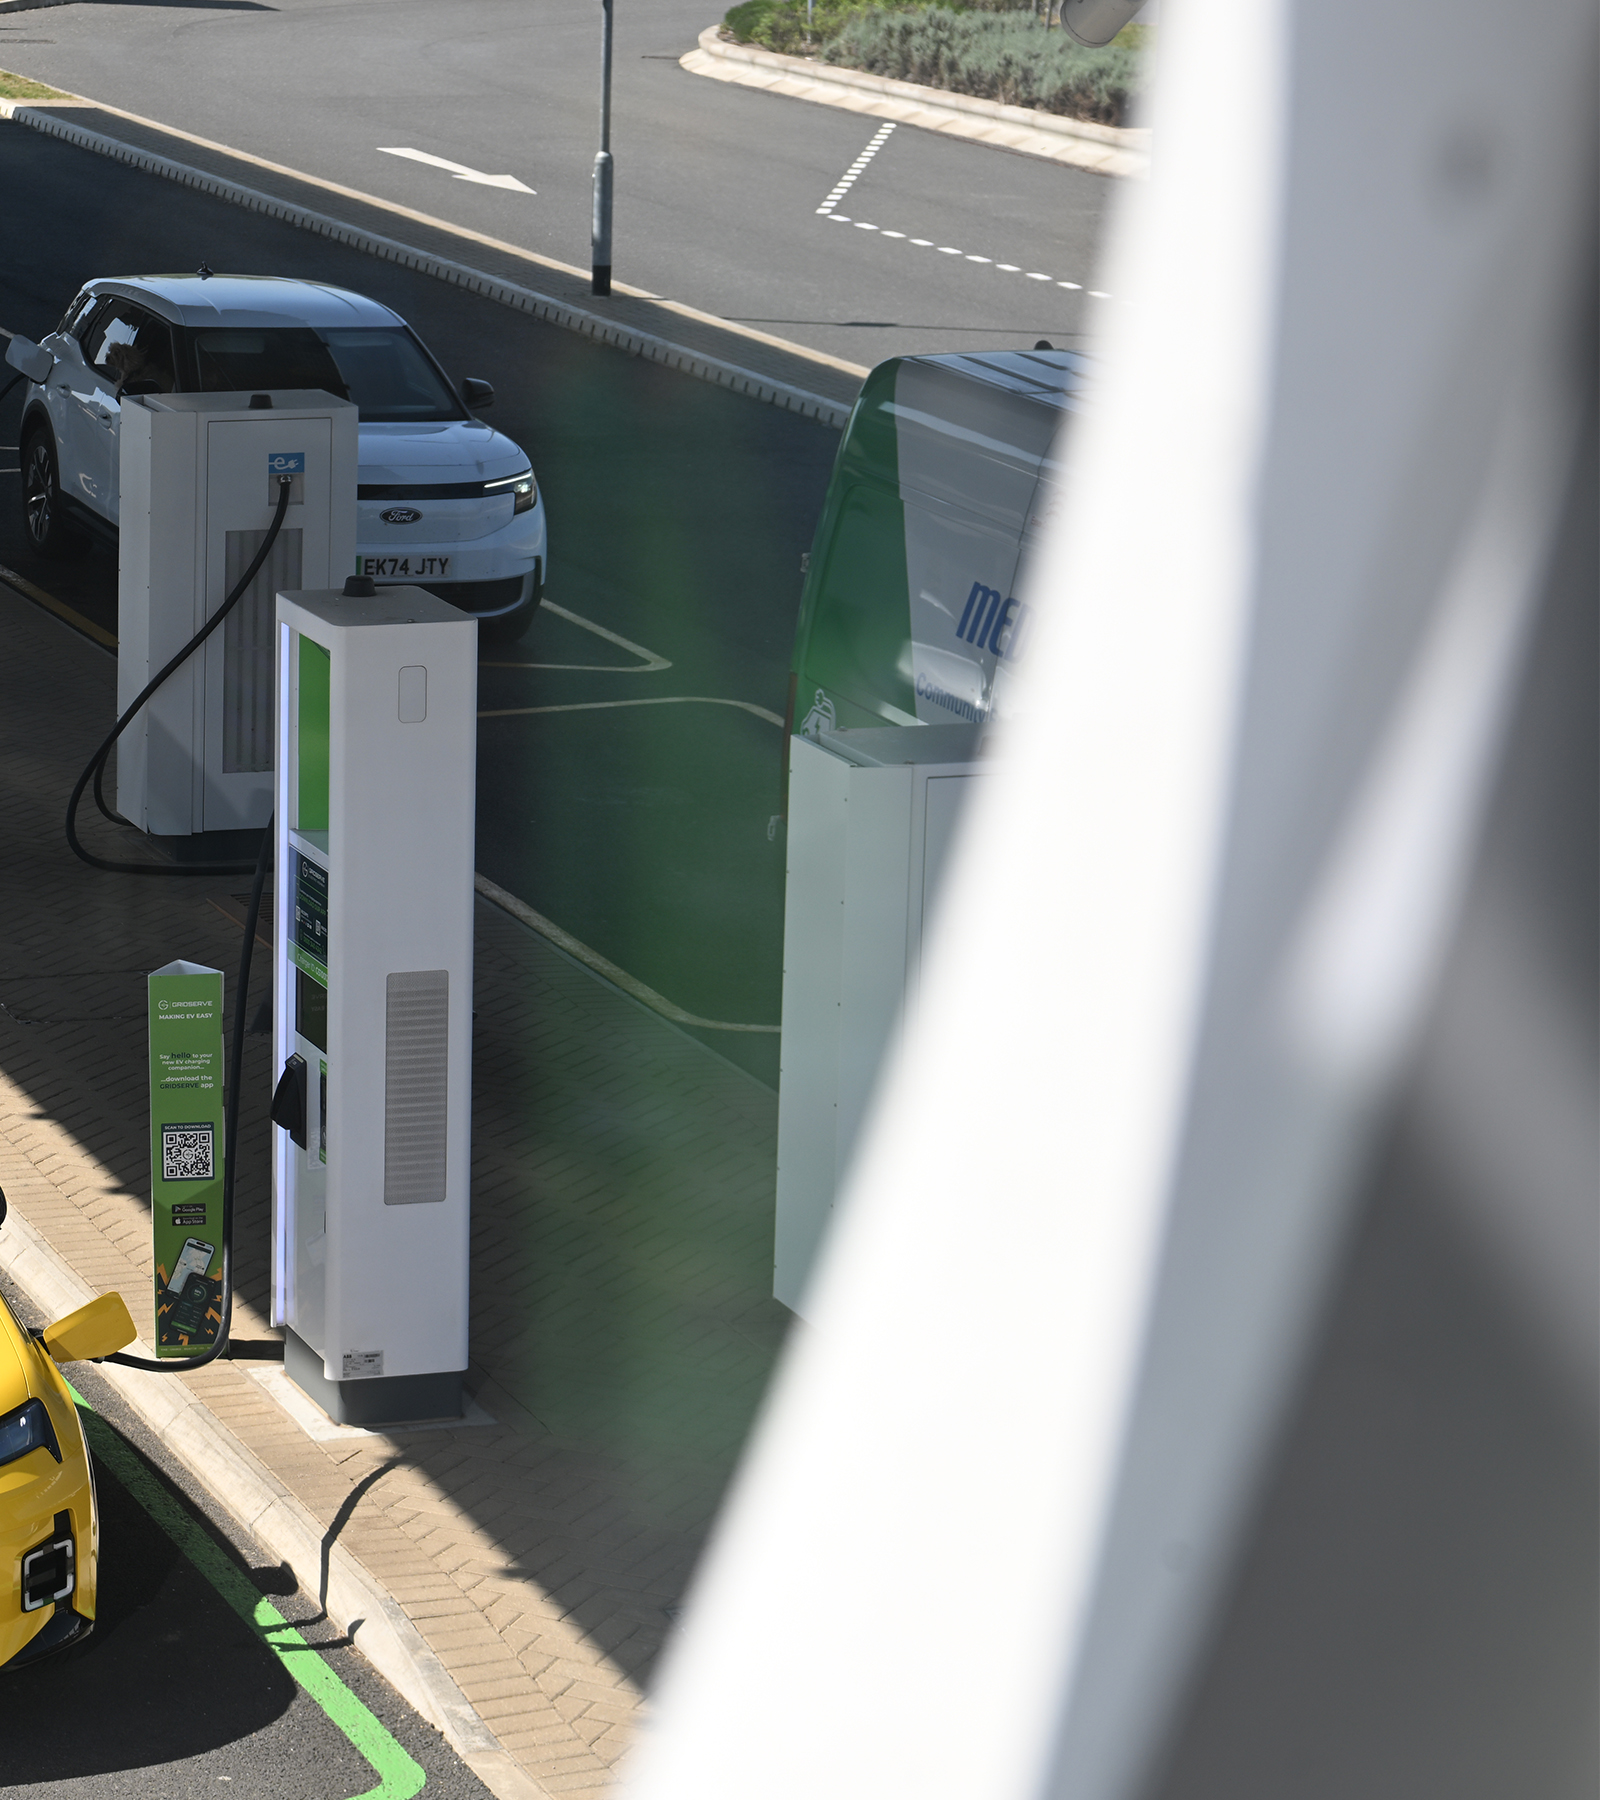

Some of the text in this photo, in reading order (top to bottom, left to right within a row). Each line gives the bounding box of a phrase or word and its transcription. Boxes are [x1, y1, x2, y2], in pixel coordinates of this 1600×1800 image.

[388, 510, 414, 522] Ford
[364, 557, 449, 576] EK74 JTY
